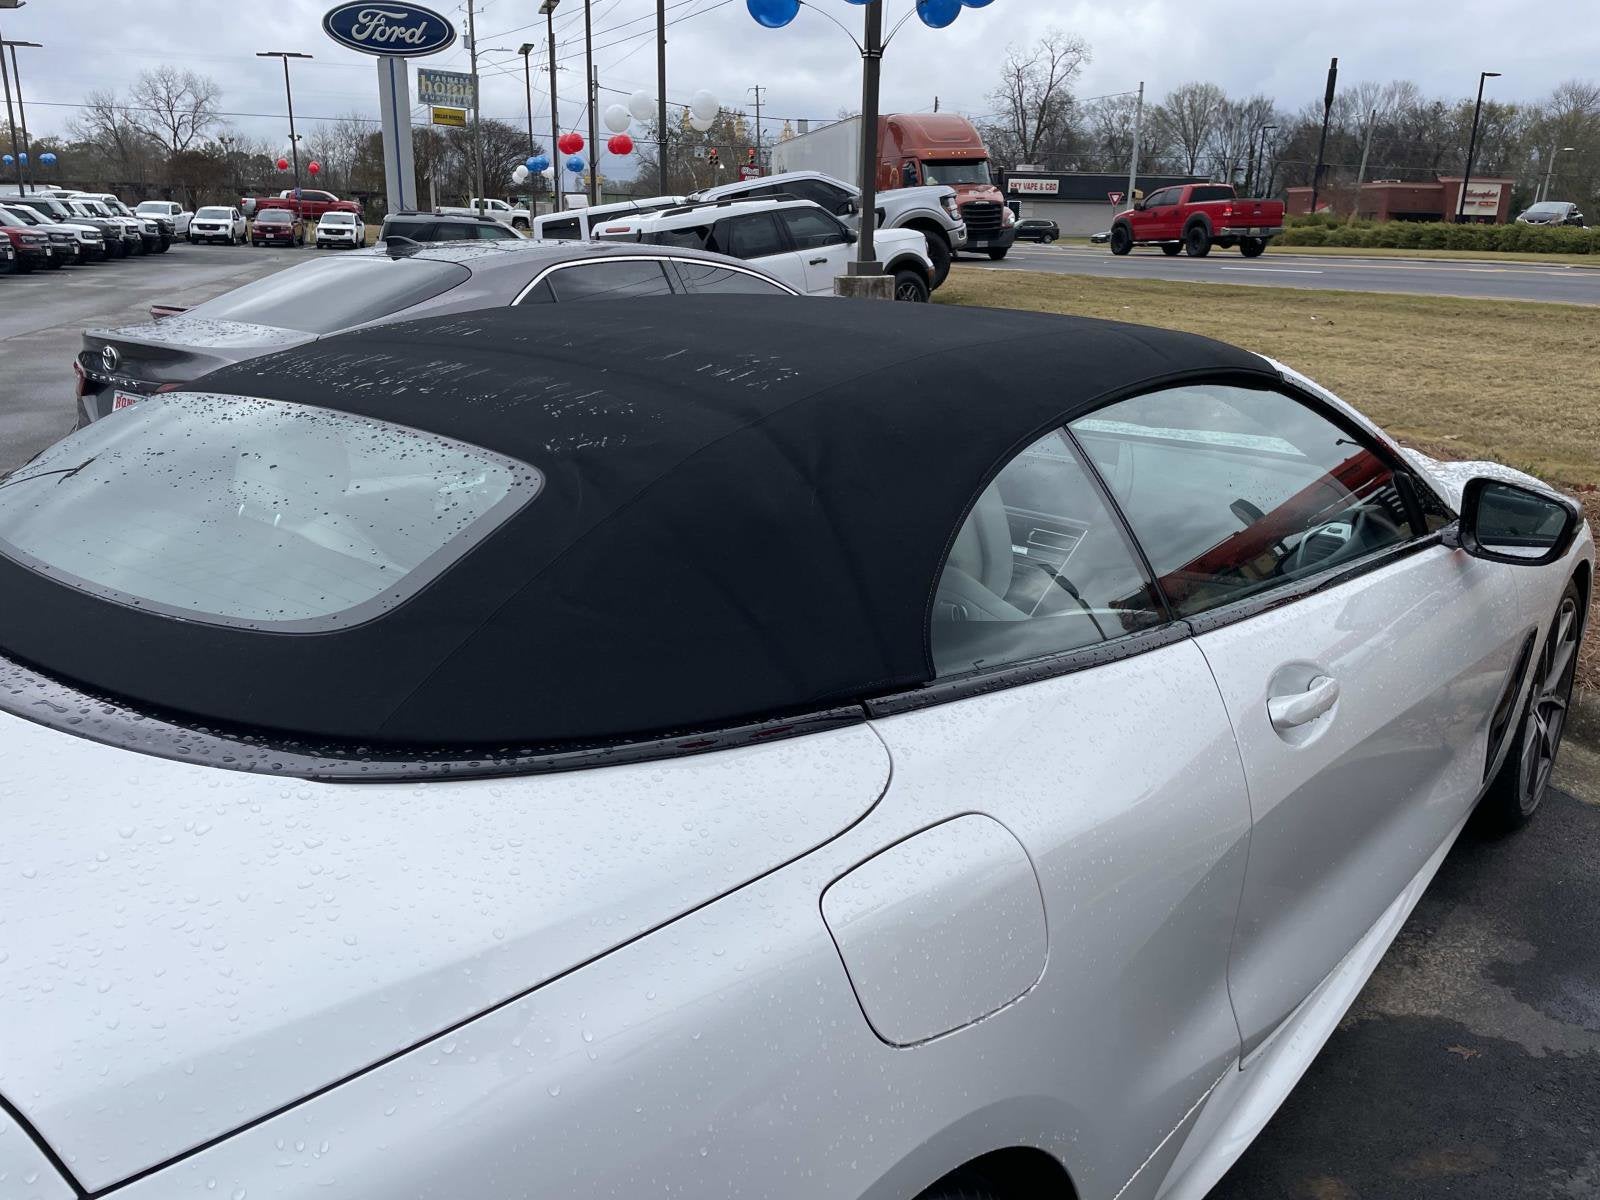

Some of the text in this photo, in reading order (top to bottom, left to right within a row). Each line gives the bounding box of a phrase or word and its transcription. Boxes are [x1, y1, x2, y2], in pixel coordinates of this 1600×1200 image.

[352, 9, 427, 44] Ford
[1023, 182, 1038, 190] VAPE
[1045, 183, 1056, 191] CBD
